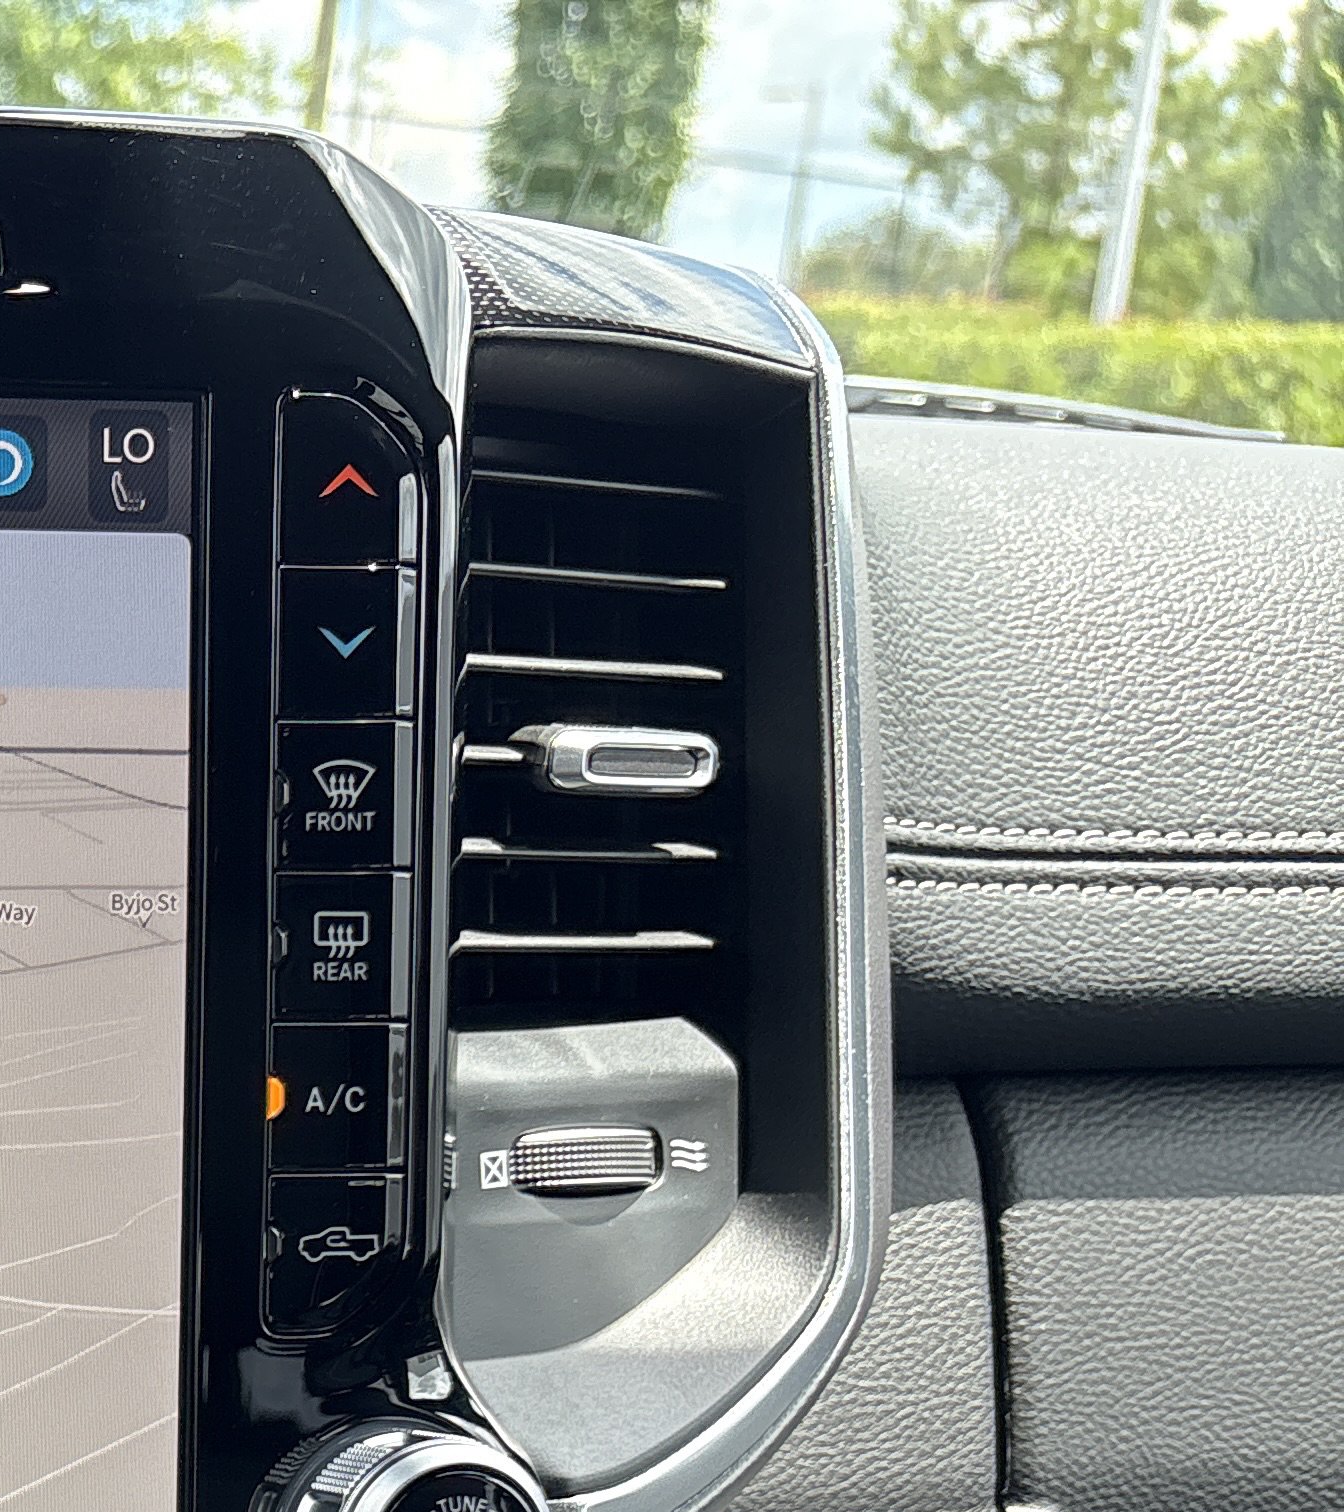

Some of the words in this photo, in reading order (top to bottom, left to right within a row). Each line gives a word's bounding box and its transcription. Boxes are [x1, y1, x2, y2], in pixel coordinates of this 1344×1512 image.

[102, 427, 154, 463] LO
[305, 810, 376, 832] FRONT
[111, 892, 152, 916] Byjo
[156, 893, 177, 913] St
[312, 962, 369, 982] REAR
[304, 1084, 366, 1114] A/C
